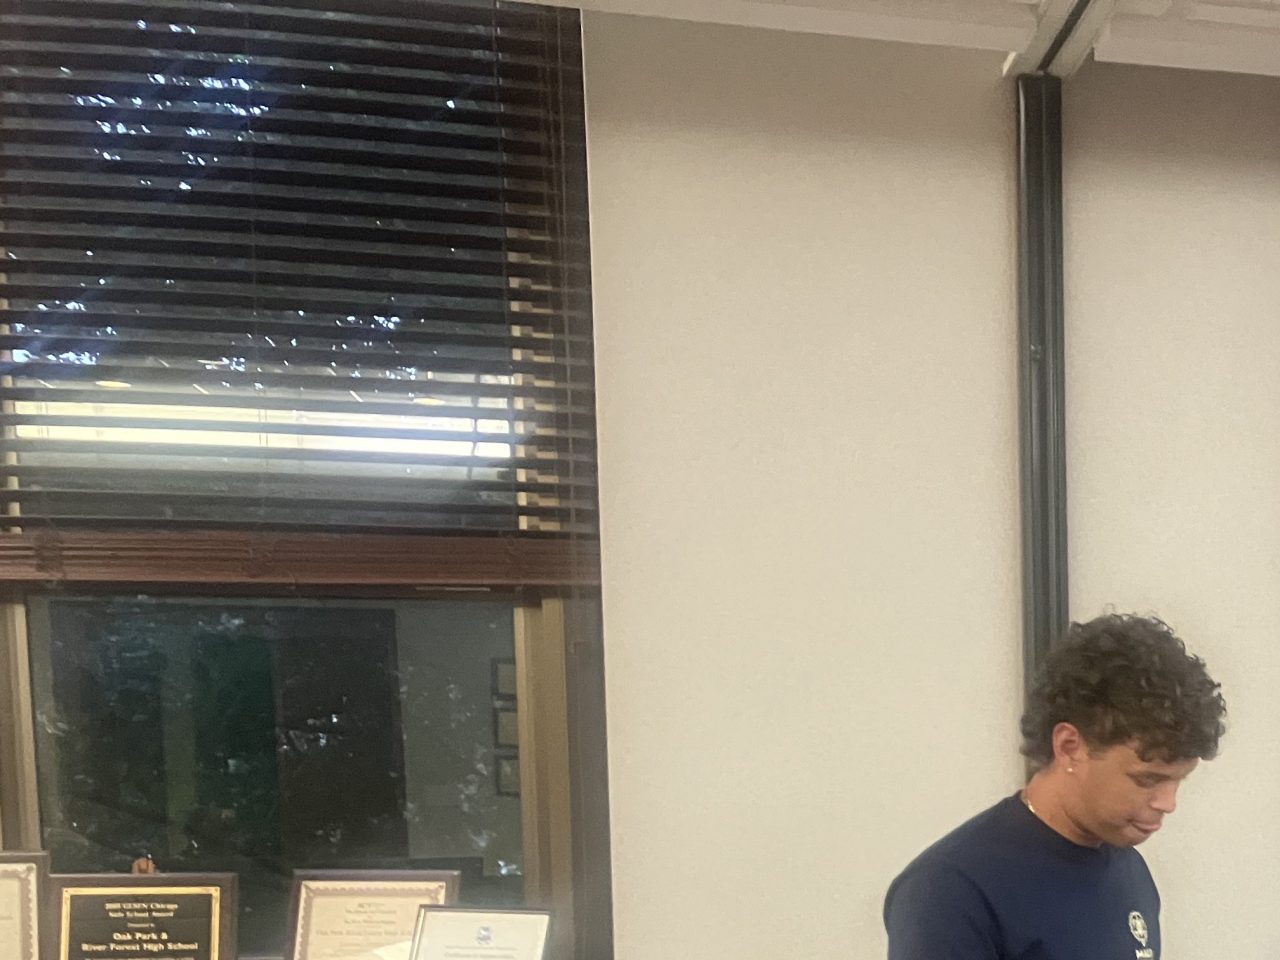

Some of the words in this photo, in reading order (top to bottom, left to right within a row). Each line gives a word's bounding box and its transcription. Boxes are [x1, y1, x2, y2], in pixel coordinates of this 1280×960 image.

[112, 932, 132, 940] Oak
[135, 932, 157, 940] Park
[81, 943, 107, 951] River
[110, 943, 140, 951] Forest
[143, 943, 165, 952] High
[167, 942, 198, 950] School
